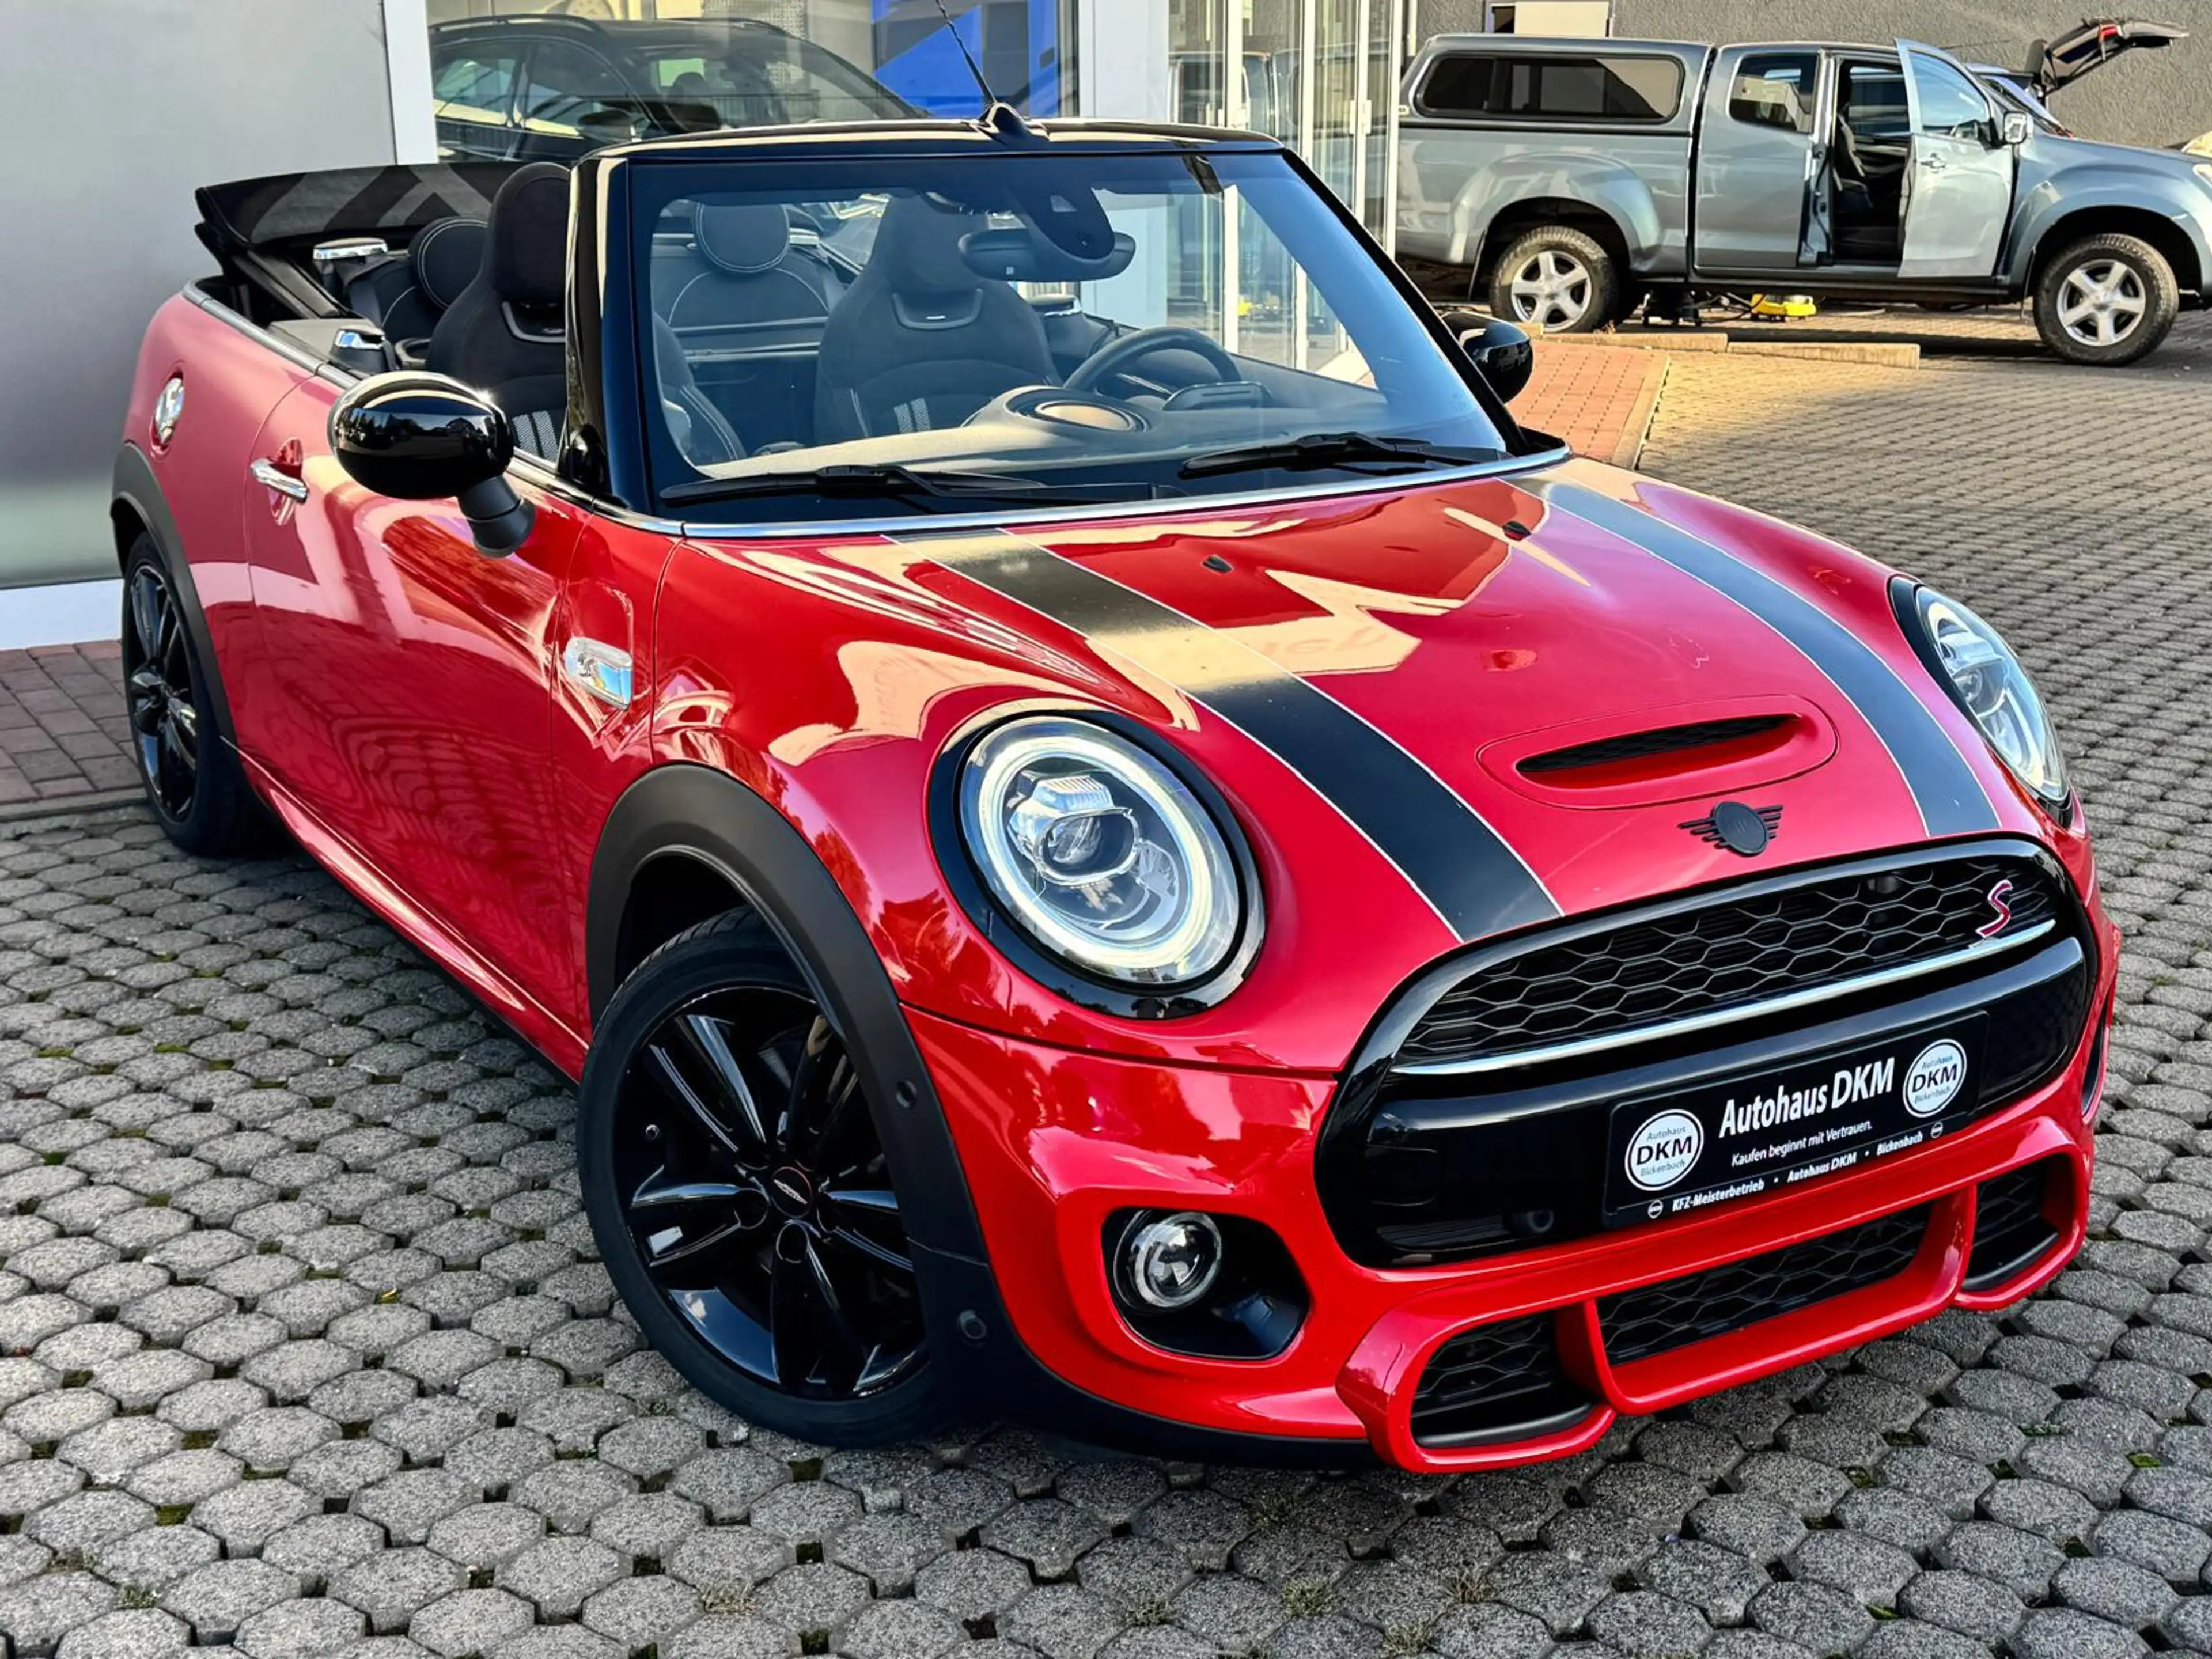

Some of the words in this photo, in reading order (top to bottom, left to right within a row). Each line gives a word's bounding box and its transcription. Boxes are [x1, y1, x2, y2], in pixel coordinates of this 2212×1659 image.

[1975, 879, 2014, 938] S
[1719, 1084, 1828, 1138] Autohaus
[1831, 1056, 1895, 1109] DKM
[1912, 1063, 1957, 1093] DKM
[1637, 1135, 1692, 1165] DKM
[1647, 1126, 1686, 1141] Autohaus
[1731, 1147, 1767, 1168] Kaufen
[1768, 1137, 1808, 1158] beginnt
[1808, 1131, 1824, 1147] mit
[1826, 1120, 1873, 1142] Vertrauen.
[1672, 1177, 1765, 1212] KFZ-Meisterbetrieb
[1787, 1161, 1829, 1183] Autohaus
[1831, 1152, 1857, 1171] DKM
[1876, 1131, 1923, 1156] Bickenbach
